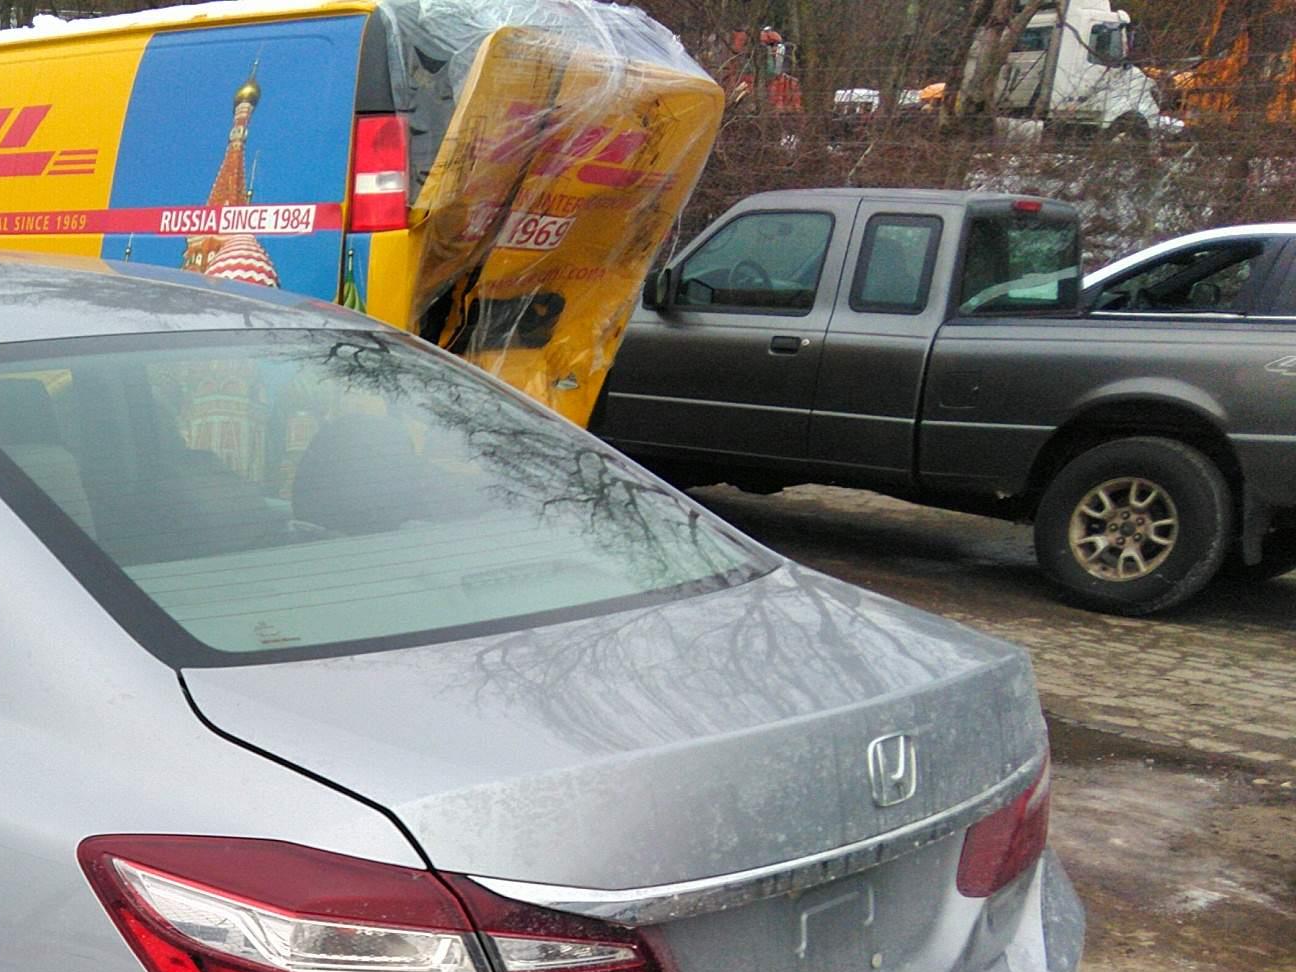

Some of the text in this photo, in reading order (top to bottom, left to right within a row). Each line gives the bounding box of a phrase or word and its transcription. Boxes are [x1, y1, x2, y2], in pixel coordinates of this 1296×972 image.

[14, 214, 50, 231] SINCE
[56, 213, 87, 230] 1969
[160, 207, 312, 232] RUSSIA SINCE 1984
